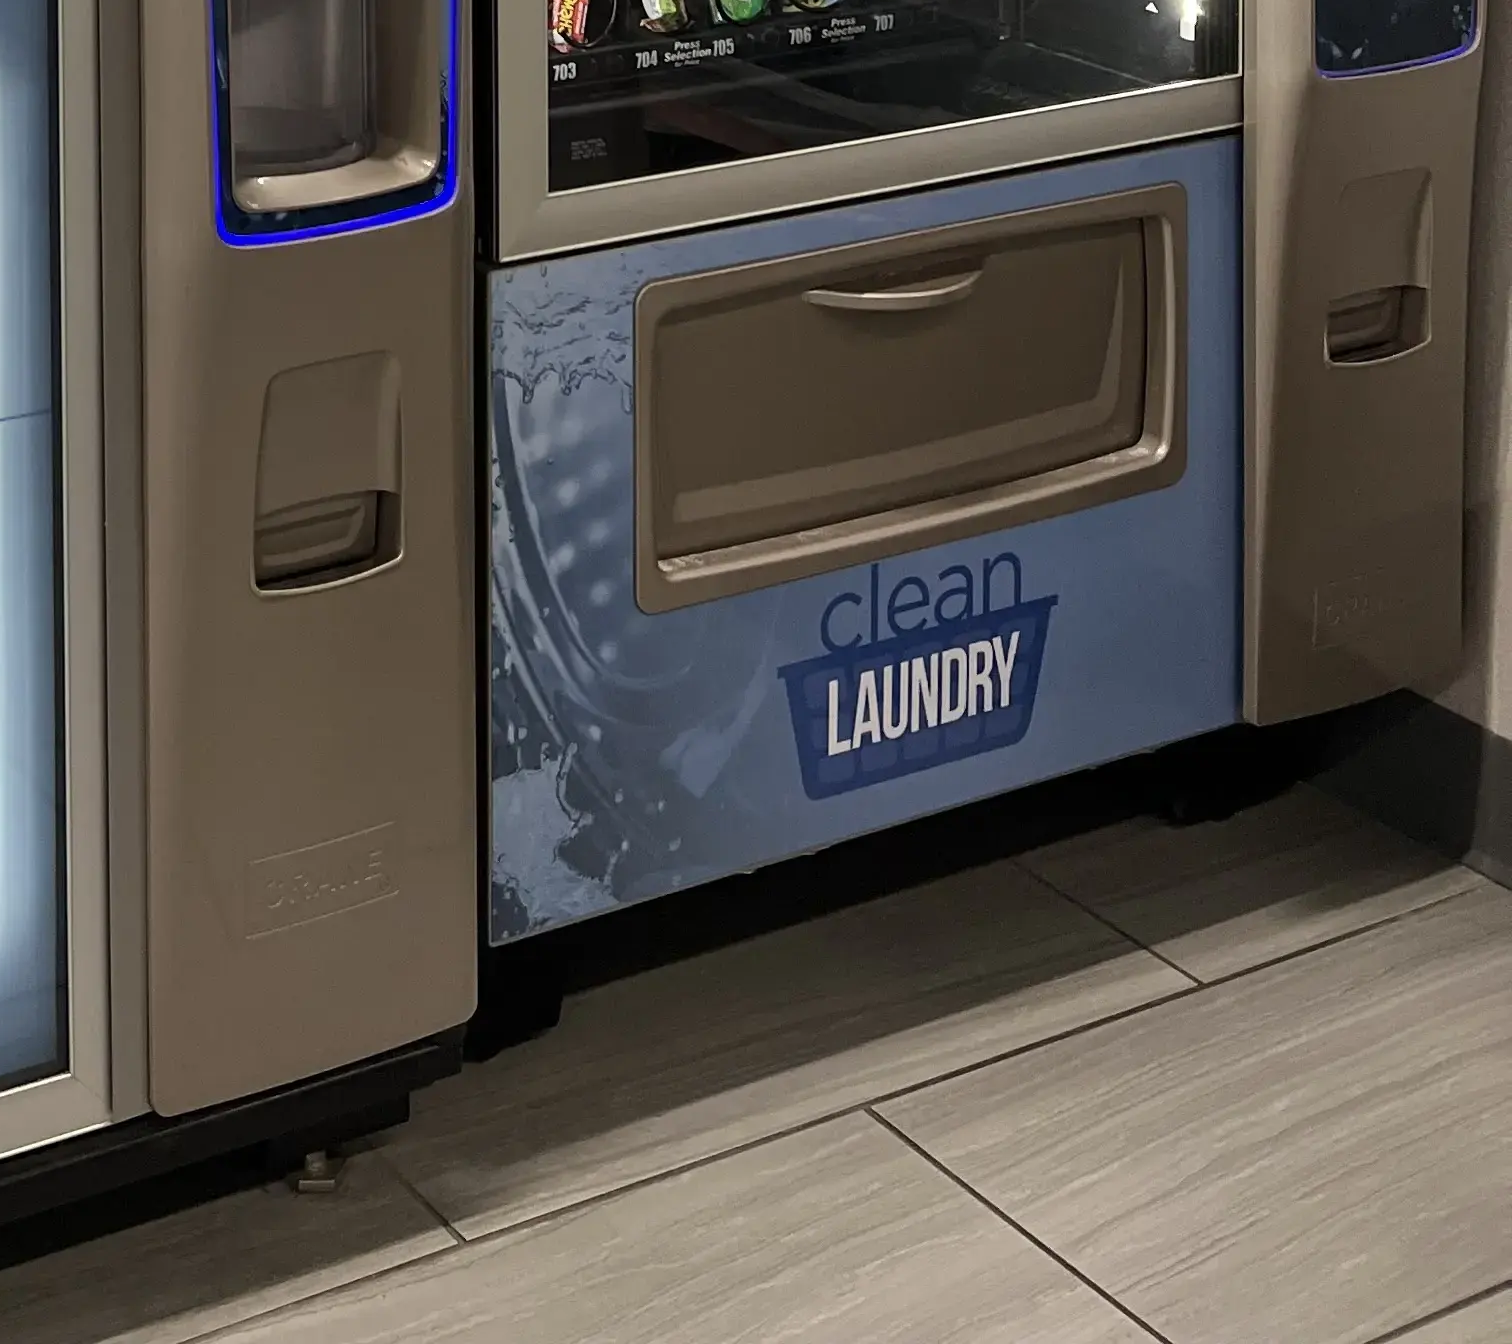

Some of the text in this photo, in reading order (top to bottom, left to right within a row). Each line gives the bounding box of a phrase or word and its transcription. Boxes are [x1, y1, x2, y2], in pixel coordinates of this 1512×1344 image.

[821, 25, 866, 39] Selection
[873, 14, 895, 32] 707
[788, 26, 812, 45] 706
[674, 40, 701, 51] Press
[635, 50, 658, 69] 704
[664, 48, 712, 63] Selection
[552, 62, 577, 81] 703
[820, 551, 1023, 651] clean
[826, 630, 1021, 757] LAUNDRY
